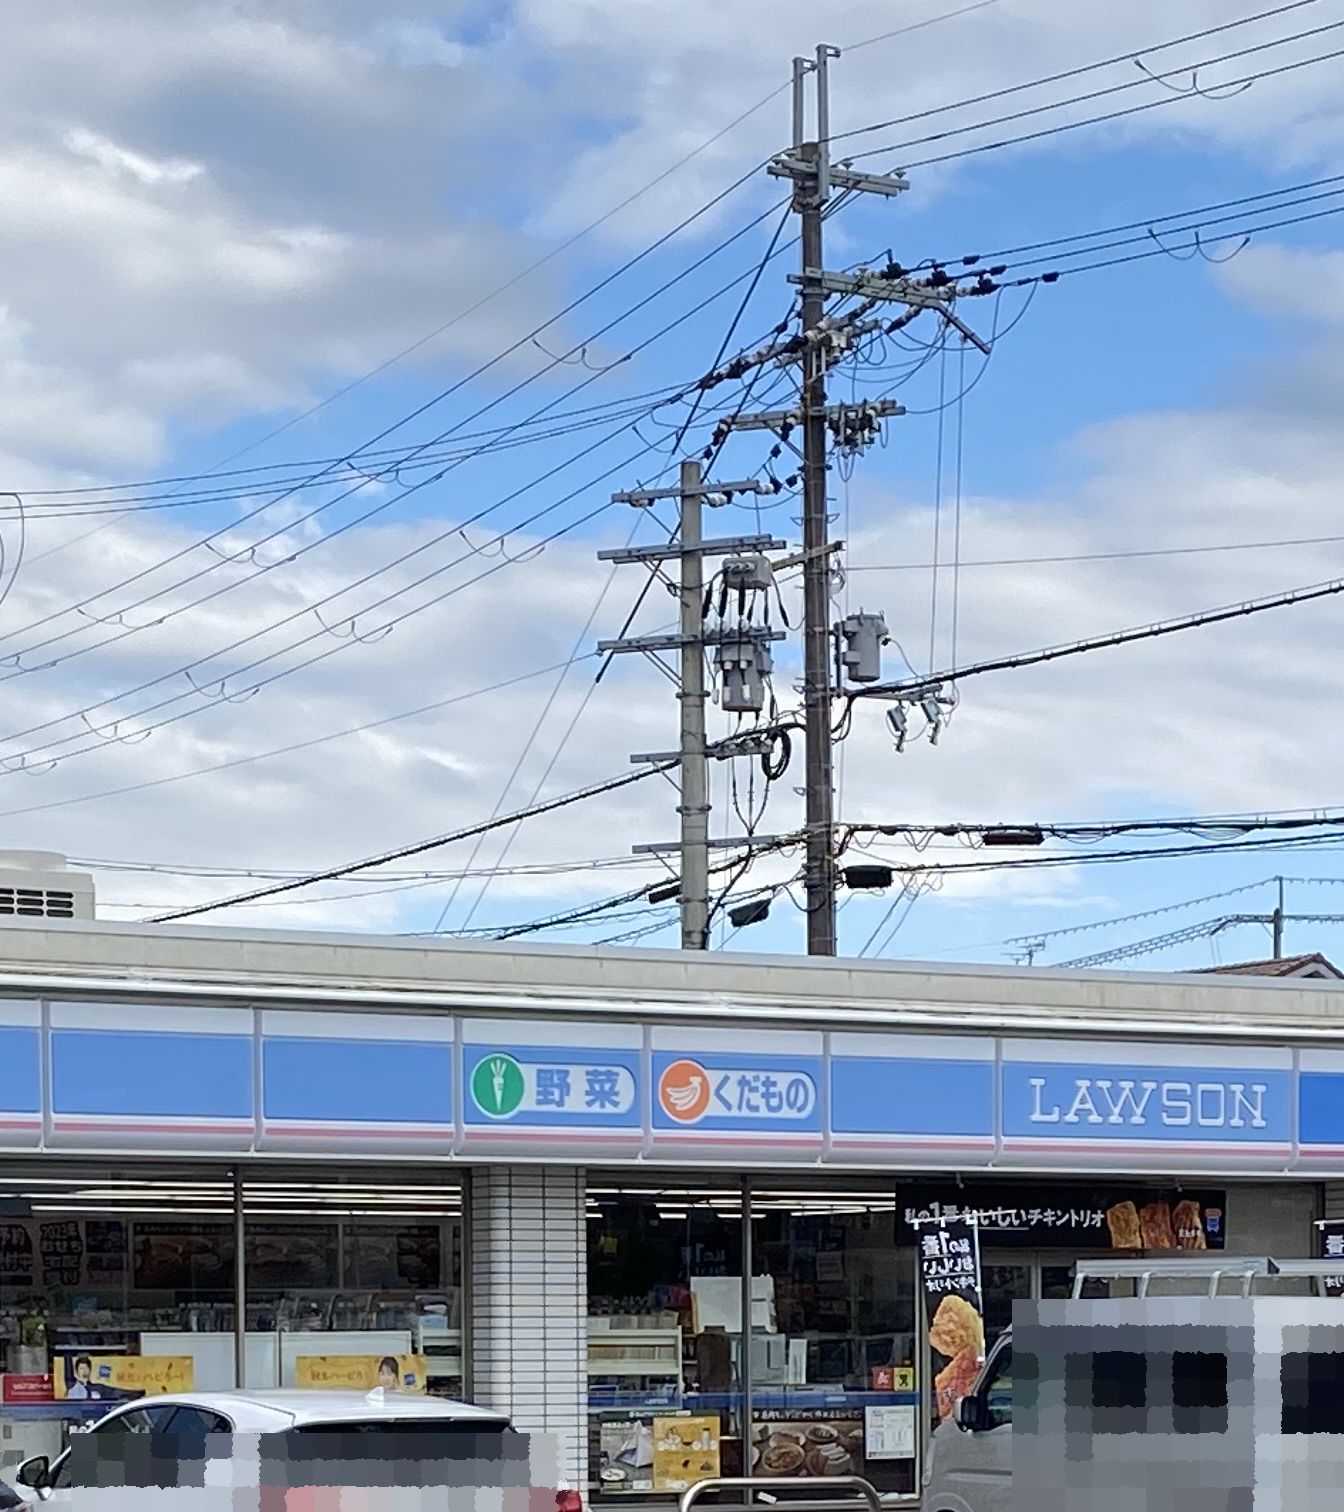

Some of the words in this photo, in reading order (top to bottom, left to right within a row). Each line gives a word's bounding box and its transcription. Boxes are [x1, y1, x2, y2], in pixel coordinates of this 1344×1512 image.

[536, 1068, 620, 1109] 野菜
[714, 1074, 810, 1113] くだもの
[1029, 1077, 1268, 1128] LAWSON
